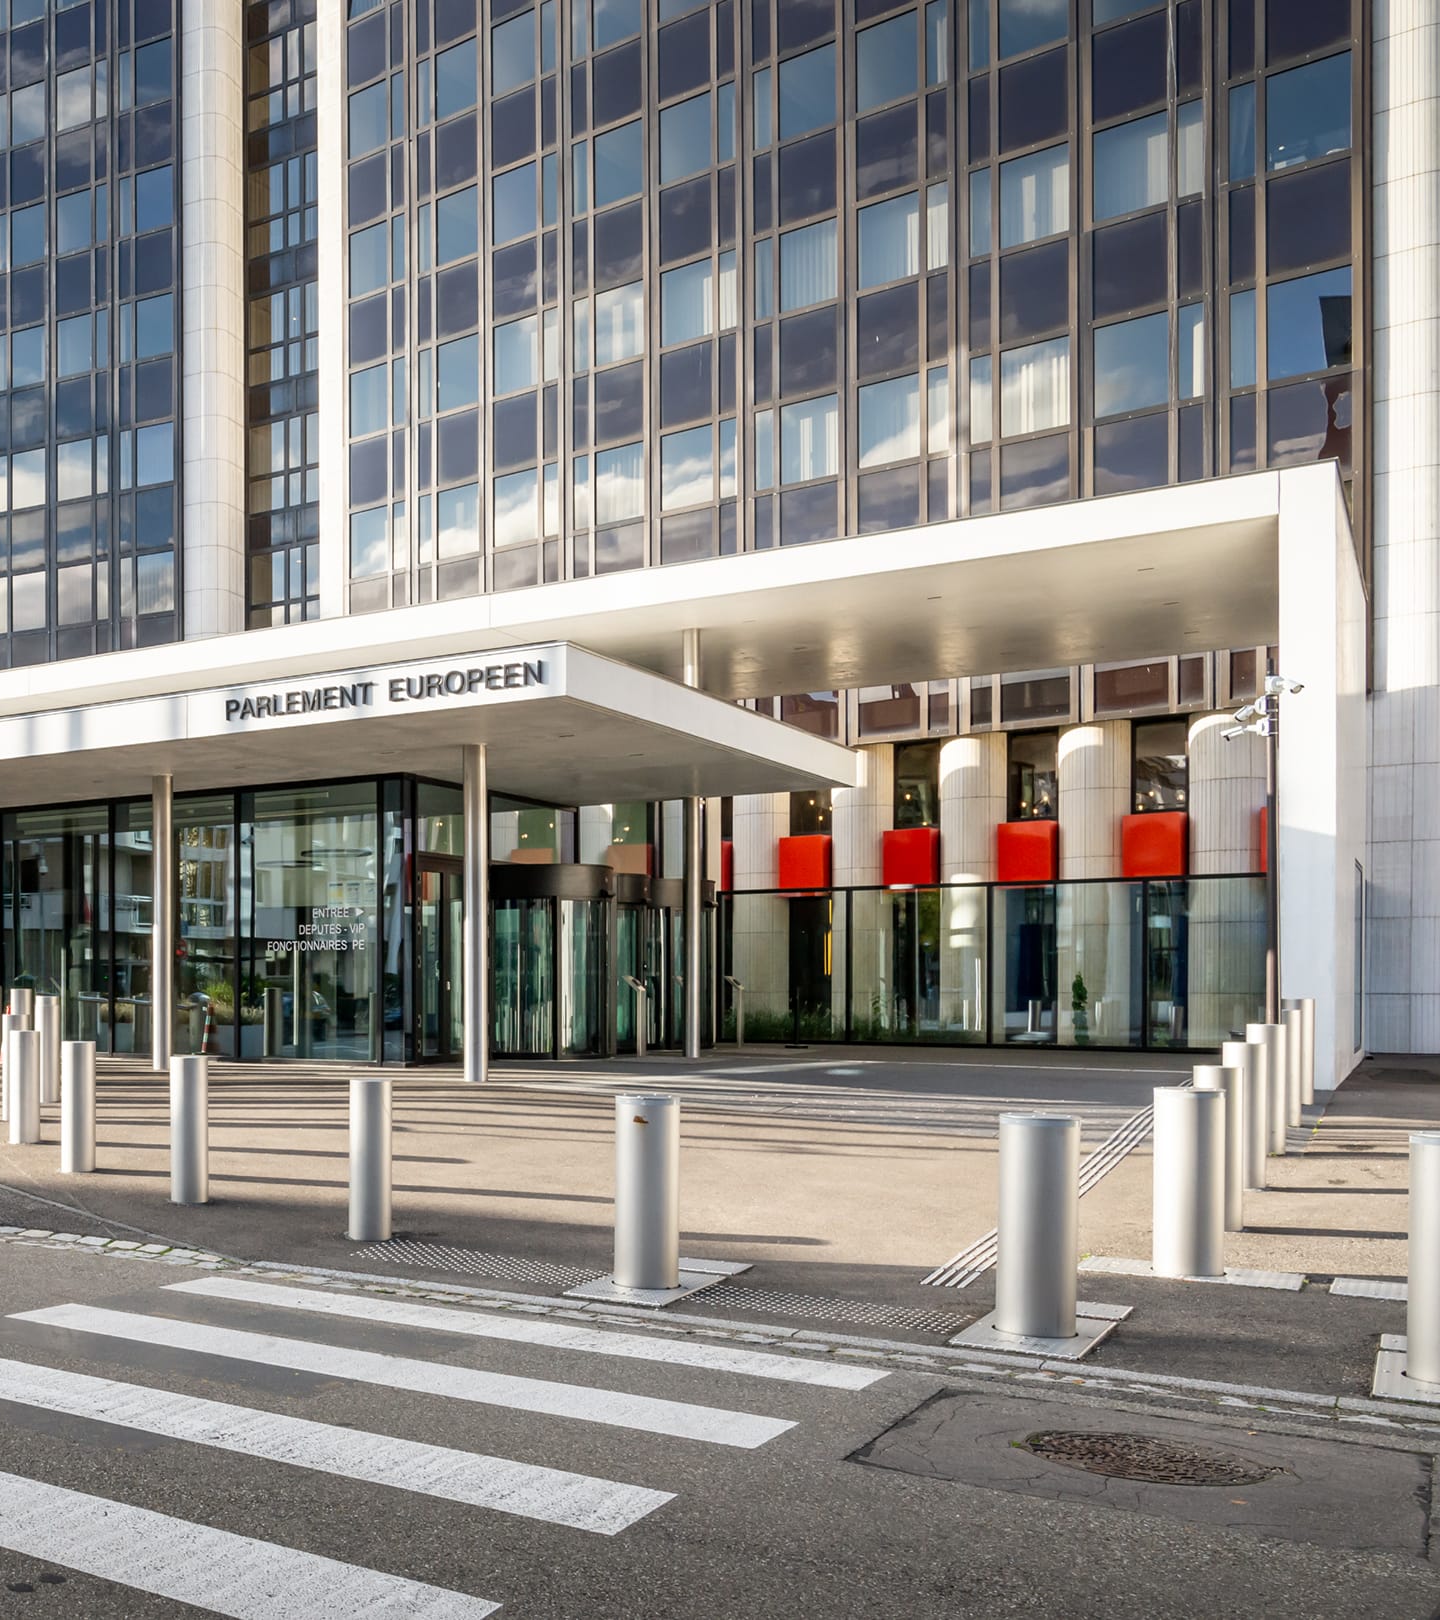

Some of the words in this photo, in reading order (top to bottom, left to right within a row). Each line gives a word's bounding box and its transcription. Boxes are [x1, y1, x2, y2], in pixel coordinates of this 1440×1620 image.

[224, 681, 376, 721] PARLEMENT
[388, 659, 545, 702] EUROPEEN
[312, 907, 349, 919] ENTREE
[298, 924, 342, 935] DEPUTES
[349, 922, 365, 934] VIP
[267, 940, 348, 952] FONCTIONNAIRES
[352, 939, 365, 950] PE
